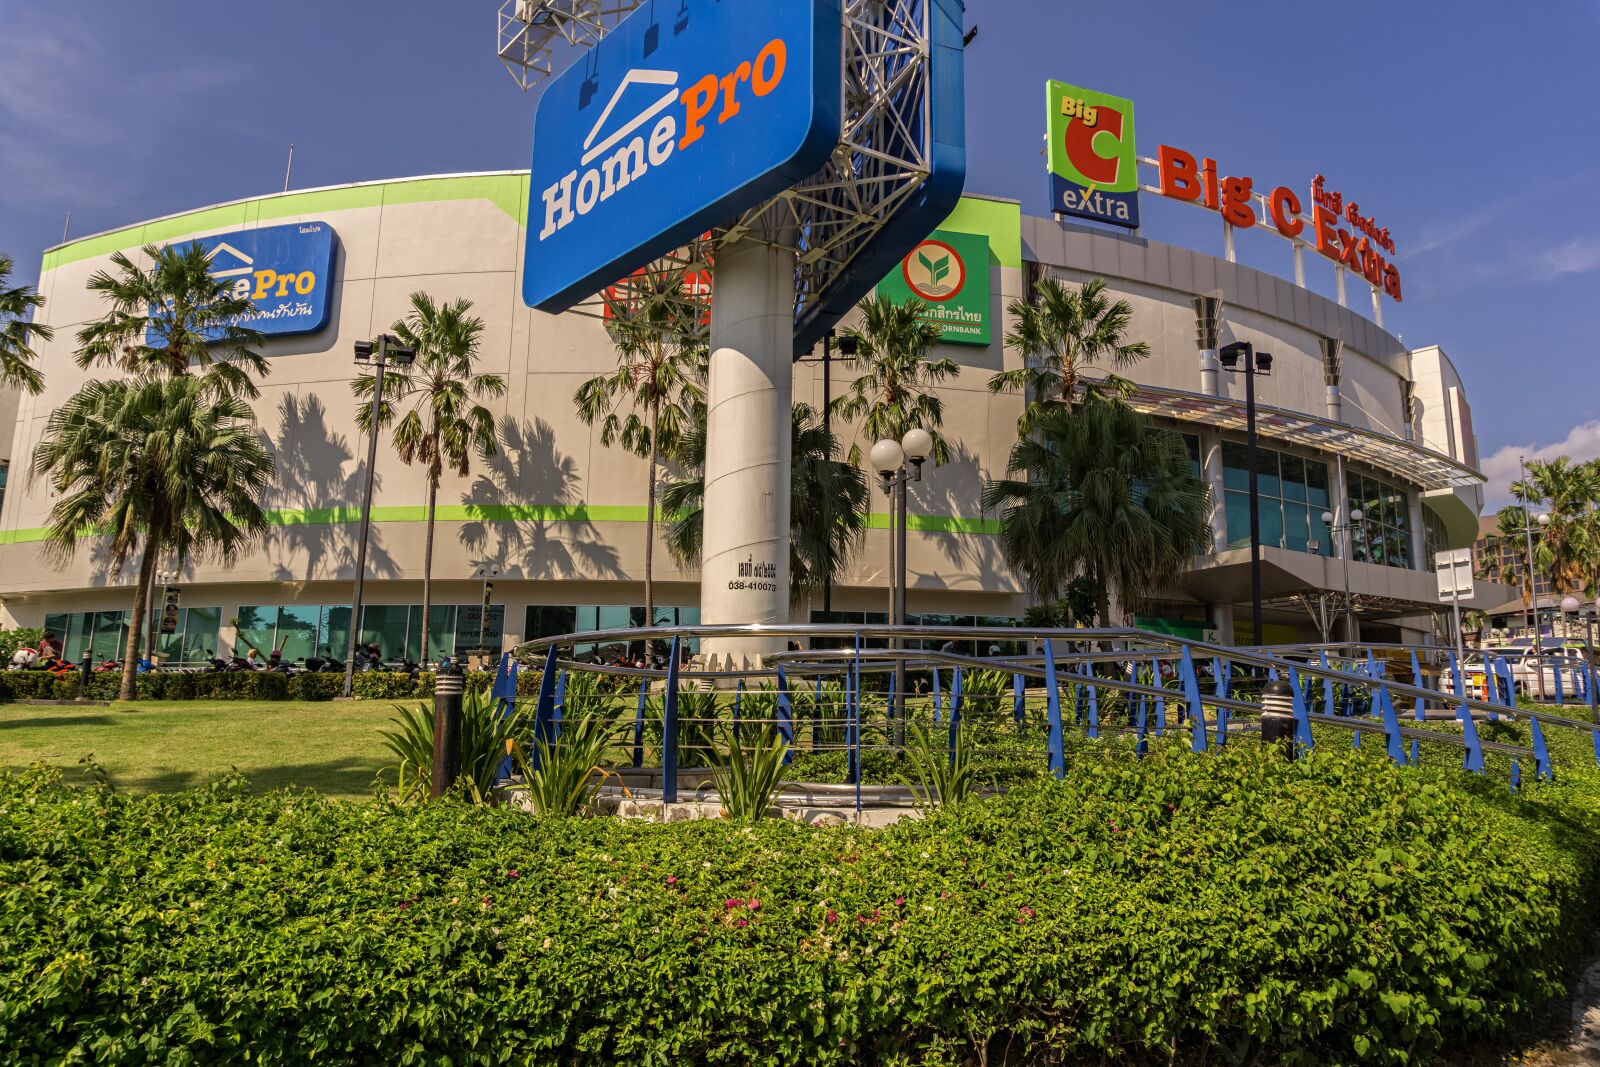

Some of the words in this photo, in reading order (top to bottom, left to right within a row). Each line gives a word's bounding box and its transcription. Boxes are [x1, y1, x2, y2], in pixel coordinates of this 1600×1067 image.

[539, 38, 787, 241] HomePro
[1061, 95, 1097, 127] Big
[1065, 105, 1123, 185] C
[1158, 144, 1255, 229] Big
[1269, 186, 1304, 238] C
[1314, 205, 1402, 302] Extra
[728, 581, 777, 592] 038-410073
